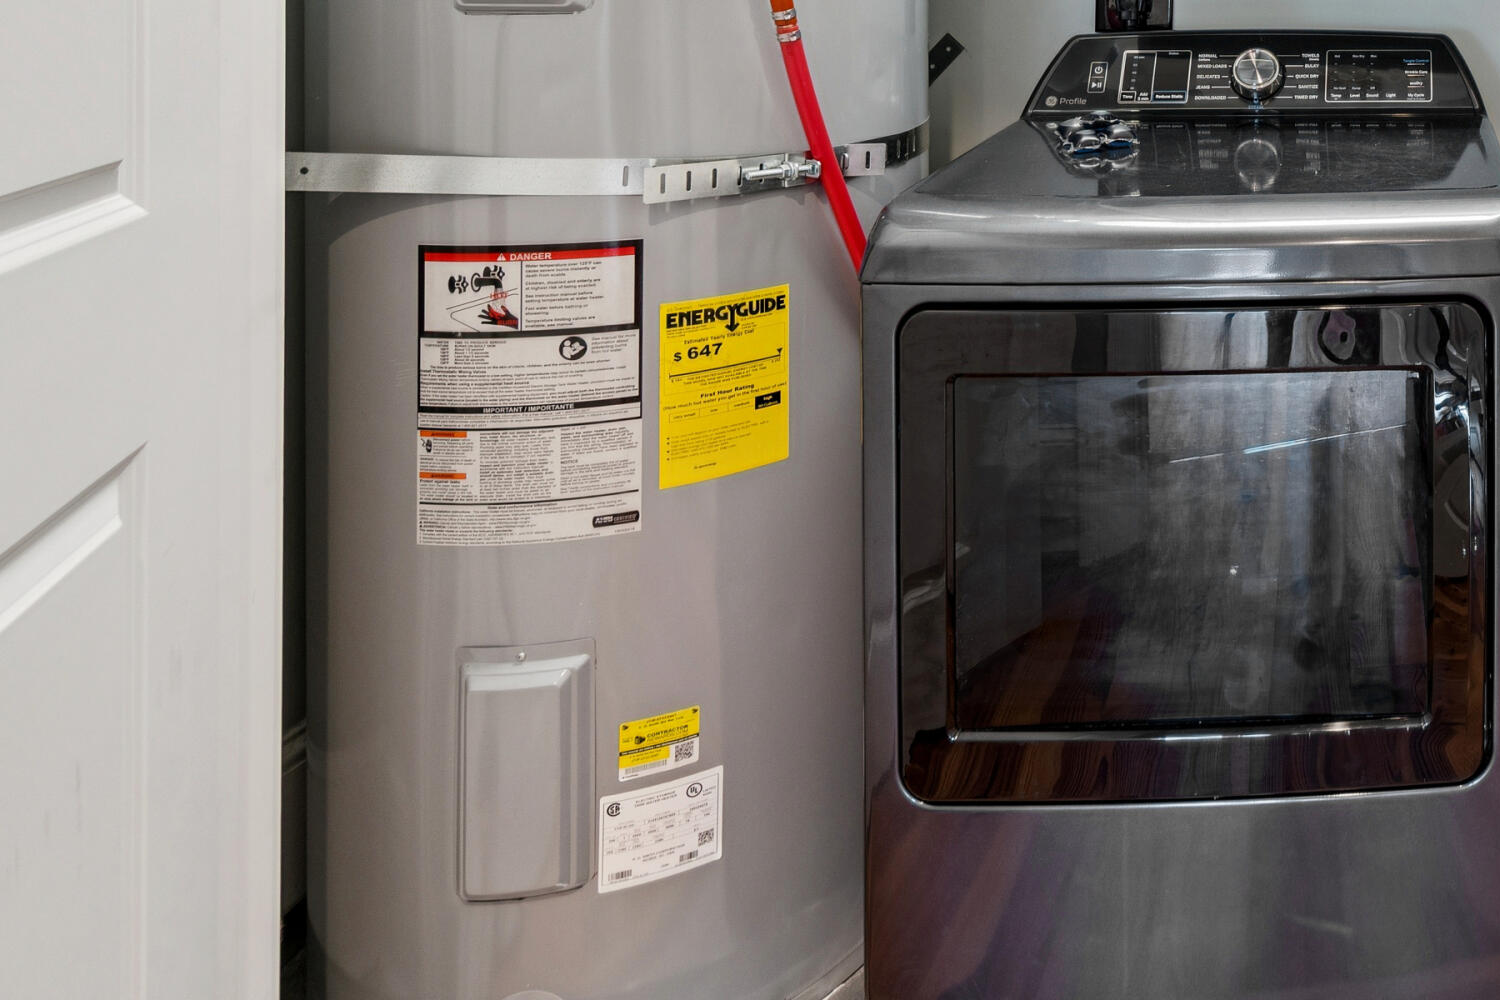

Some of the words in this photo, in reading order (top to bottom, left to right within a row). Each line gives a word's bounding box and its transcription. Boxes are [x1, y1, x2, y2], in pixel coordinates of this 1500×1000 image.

[1060, 97, 1087, 105] Profile
[509, 252, 552, 261] DANGER
[666, 294, 786, 332] ENERGYGUIDE
[673, 352, 682, 362] $
[687, 342, 722, 359] 647
[734, 384, 754, 392] Rating
[483, 406, 524, 414] IMPORTANT
[528, 403, 575, 412] IMPORTANTE
[646, 724, 689, 738] CONTRACTOR
